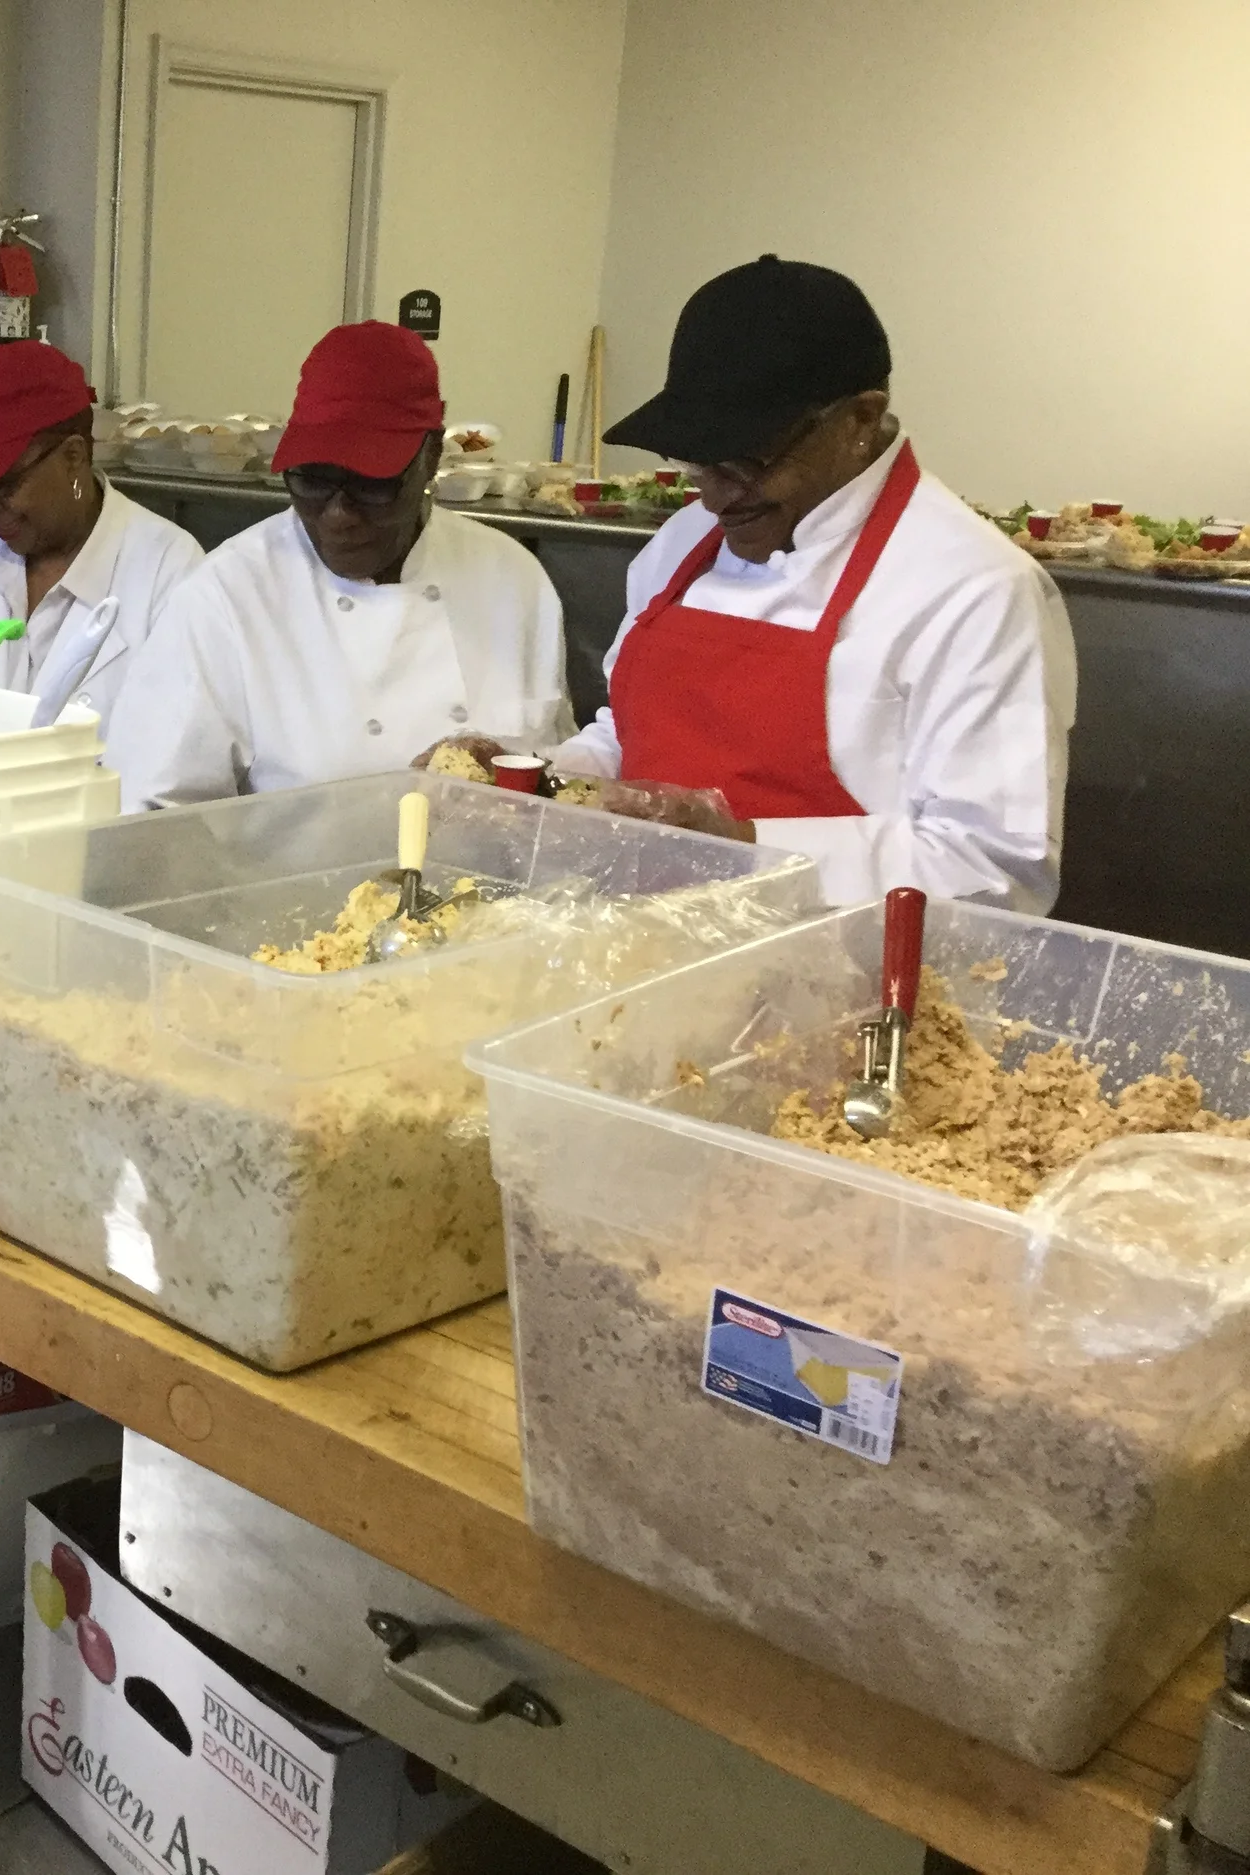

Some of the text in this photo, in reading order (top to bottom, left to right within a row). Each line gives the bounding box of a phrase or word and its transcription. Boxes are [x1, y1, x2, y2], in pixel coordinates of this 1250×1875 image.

[28, 1697, 155, 1843] Eastern
[201, 1691, 321, 1815] PREMIUM
[202, 1731, 321, 1842] EXTRA FANCY
